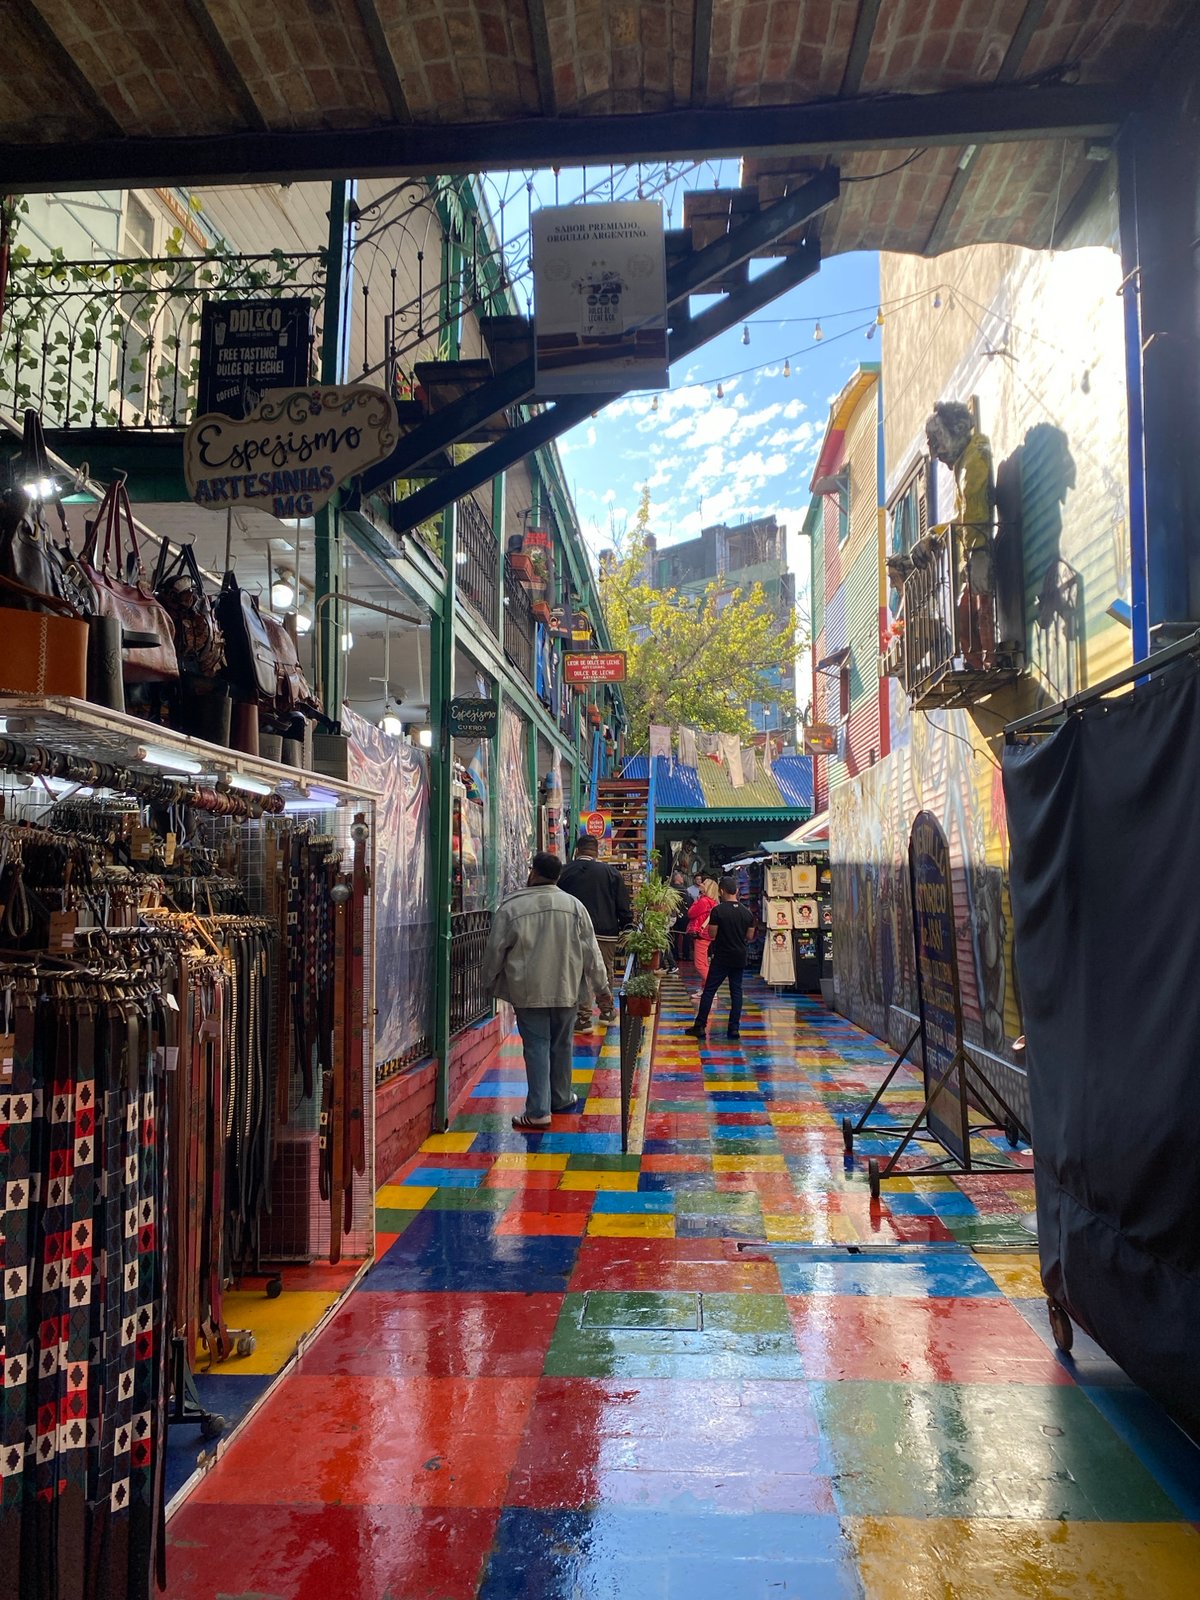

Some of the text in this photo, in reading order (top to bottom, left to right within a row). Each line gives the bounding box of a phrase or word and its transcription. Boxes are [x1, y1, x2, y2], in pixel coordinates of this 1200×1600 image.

[554, 223, 586, 233] SABOR
[546, 232, 590, 243] ORGULLO
[229, 307, 282, 333] DDL&CO
[218, 346, 278, 362] FREE TASTING!
[216, 360, 284, 376] DULCE DE LECHE!
[216, 385, 240, 403] COFFEE!
[197, 424, 363, 471] Espejismo
[194, 464, 337, 500] ARTESANIAS
[273, 493, 315, 517] MG
[451, 705, 497, 722] Espejismo
